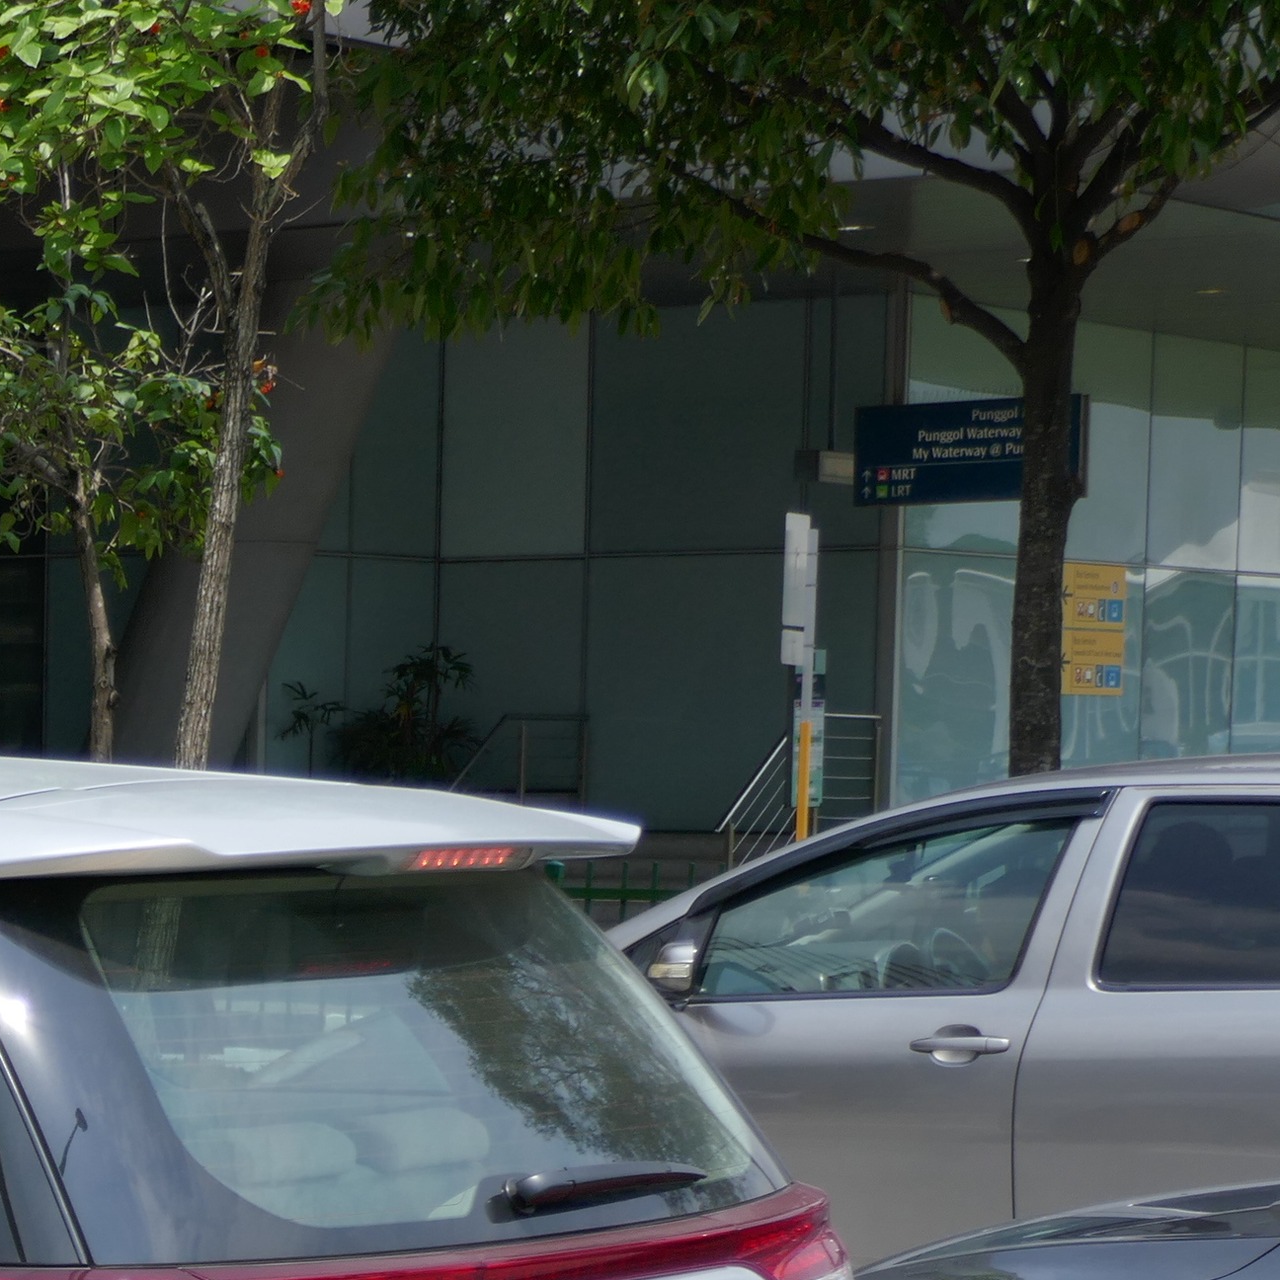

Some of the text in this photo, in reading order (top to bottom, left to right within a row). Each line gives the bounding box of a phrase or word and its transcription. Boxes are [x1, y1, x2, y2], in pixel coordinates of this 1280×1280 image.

[972, 407, 1018, 423] Punggol
[918, 426, 1023, 443] Punggol Waterway
[912, 448, 928, 461] My
[932, 445, 987, 459] Waterway
[990, 444, 1002, 457] @
[892, 468, 917, 480] MRT
[892, 485, 911, 497] LRT
